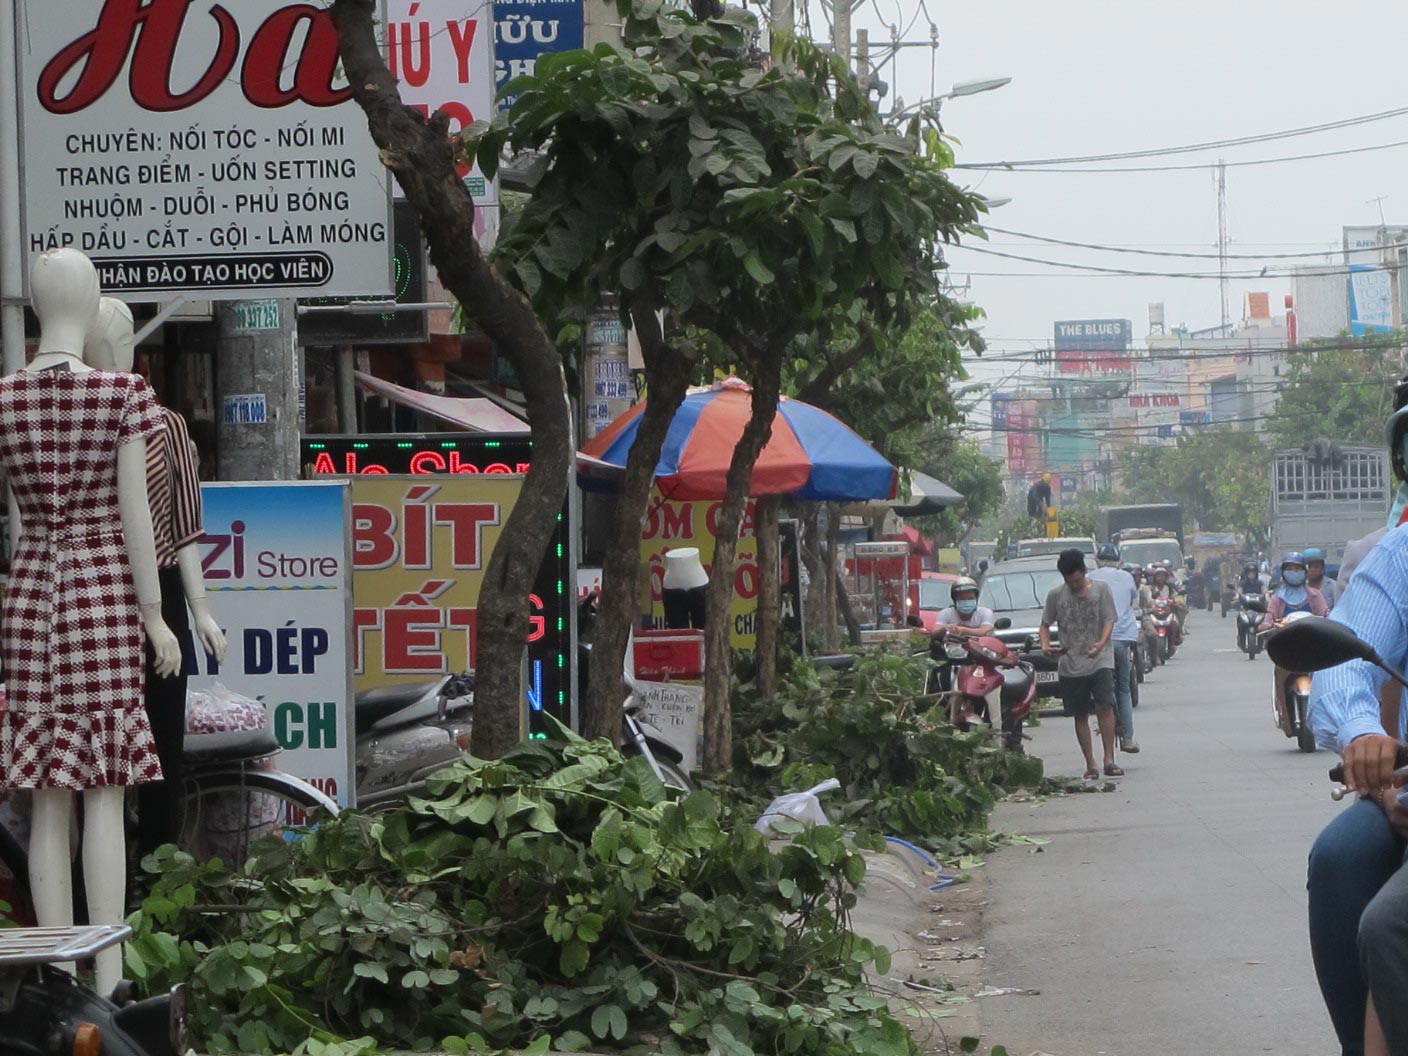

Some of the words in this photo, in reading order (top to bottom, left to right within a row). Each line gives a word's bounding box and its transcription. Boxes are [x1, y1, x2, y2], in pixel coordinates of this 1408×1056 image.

[66, 128, 162, 154] CHUYÊN:
[169, 122, 206, 150] NỐI
[213, 125, 257, 149] TÓC
[278, 120, 315, 147] NỐI
[322, 126, 345, 146] MI
[56, 165, 131, 187] TRANG
[138, 153, 191, 184] ĐIỂM
[211, 153, 257, 182] UỐN
[264, 158, 357, 183] SETTING
[64, 193, 143, 220] NHUỘM
[235, 186, 279, 213] PHỦ
[286, 187, 349, 211] BÓNG
[268, 220, 313, 246] LÀM
[320, 218, 386, 244] MÓNG
[146, 262, 187, 283] ĐÀO
[191, 265, 230, 285] TẠO
[234, 263, 275, 283] HỌC
[279, 260, 324, 280] VIÊN
[1060, 324, 1082, 336] THE
[1085, 323, 1121, 335] BLUES
[257, 551, 338, 578] Store
[243, 620, 329, 675] DÉP
